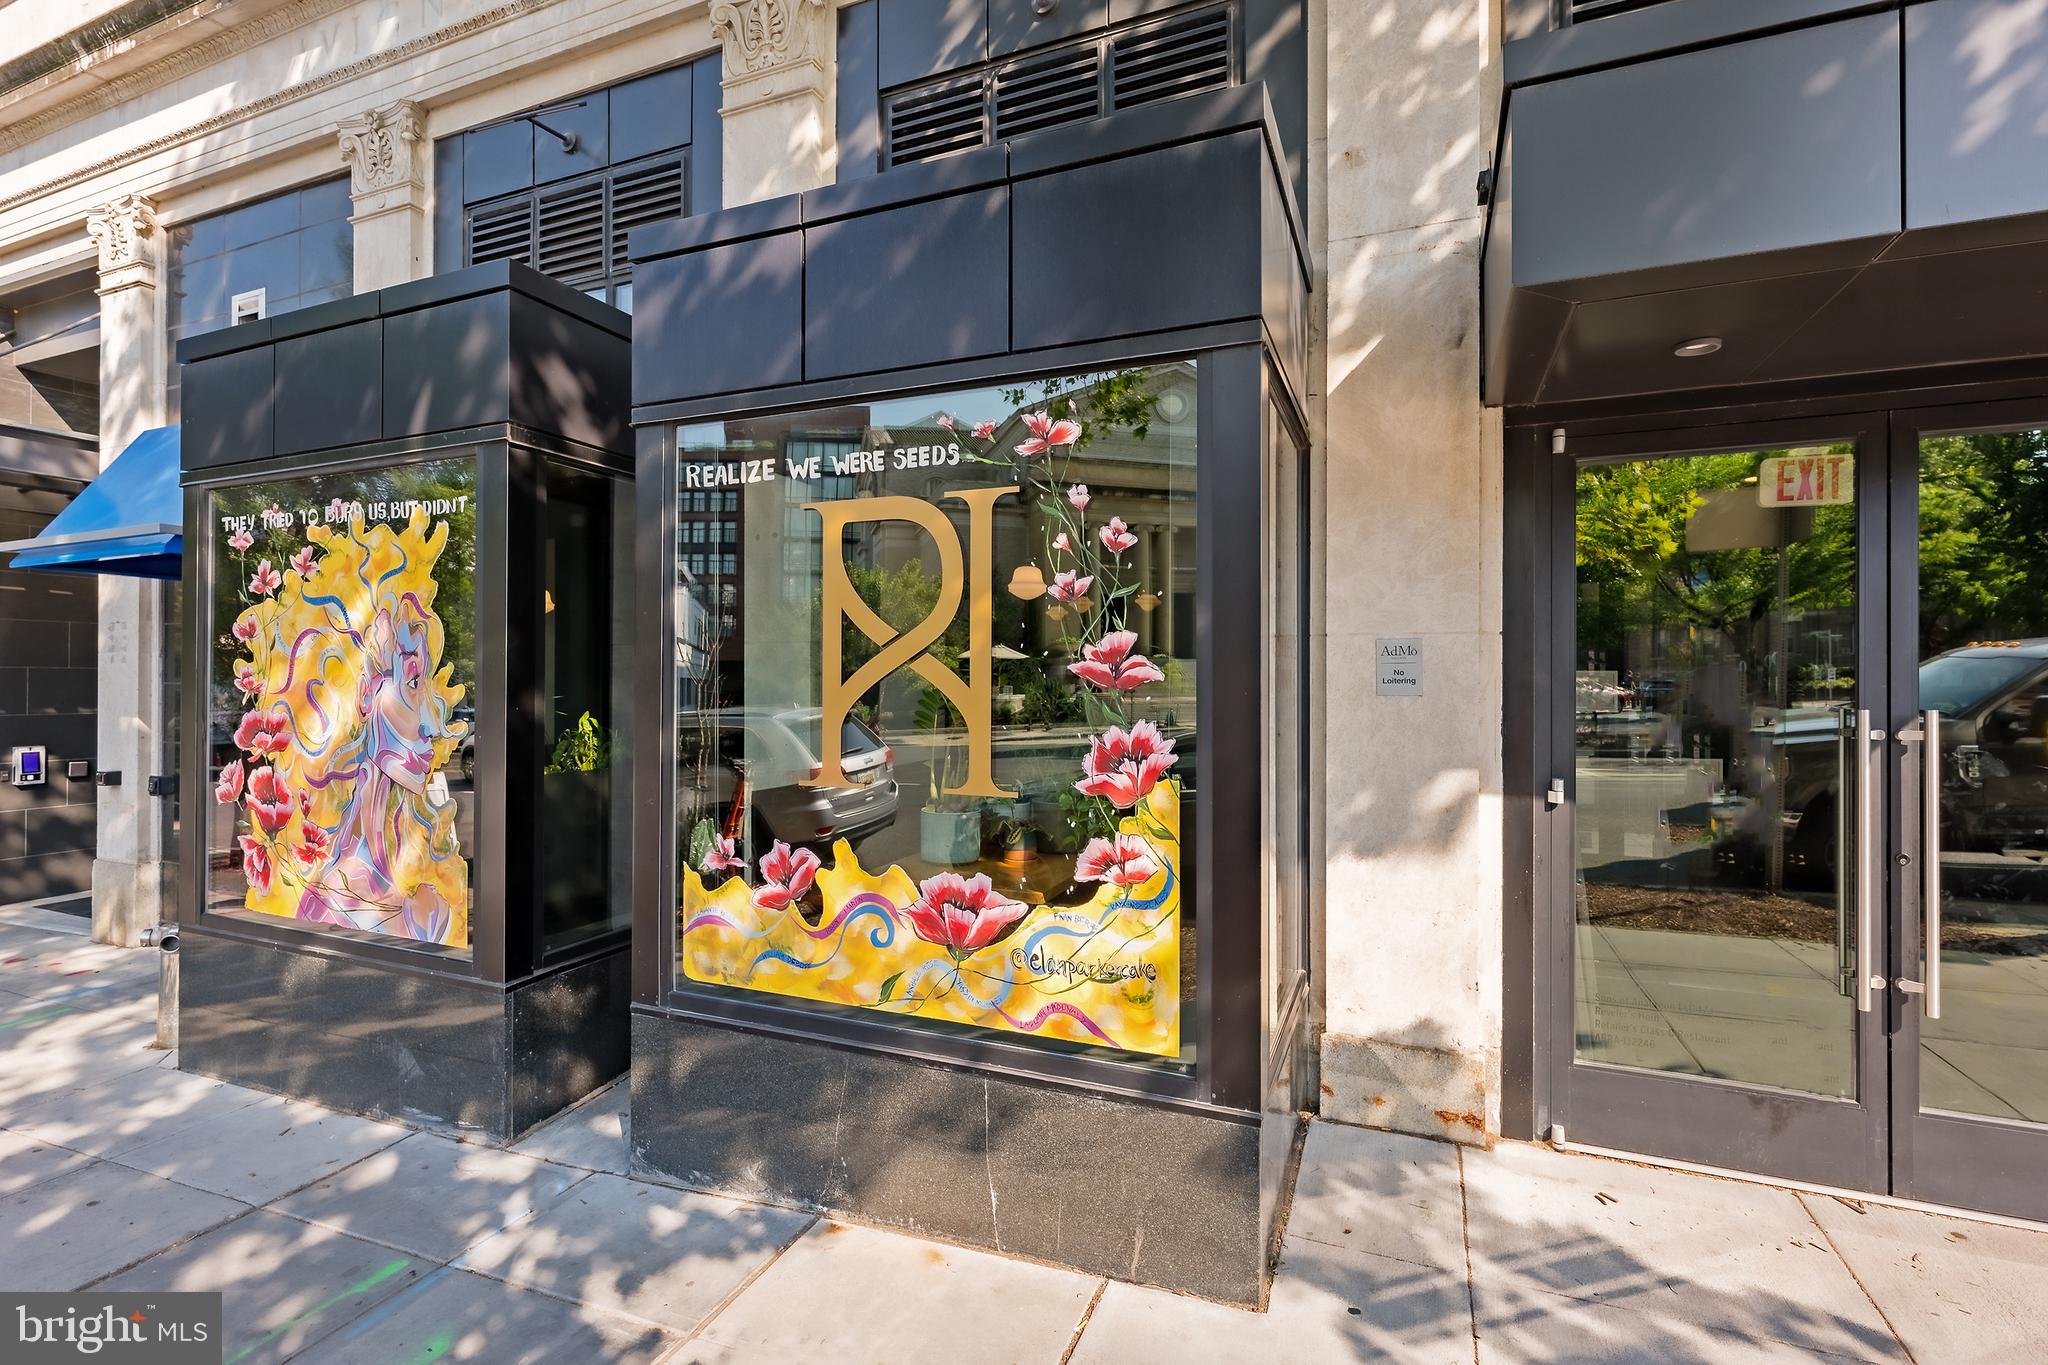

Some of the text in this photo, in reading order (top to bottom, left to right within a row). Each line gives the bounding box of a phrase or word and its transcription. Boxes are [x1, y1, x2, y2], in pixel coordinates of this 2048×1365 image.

[686, 443, 960, 488] REALIZE WE WERE SEEDS
[1776, 456, 1845, 501] EXIT
[221, 514, 256, 532] THEY
[1380, 645, 1418, 656] AdMo
[1382, 677, 1416, 686] Loitering
